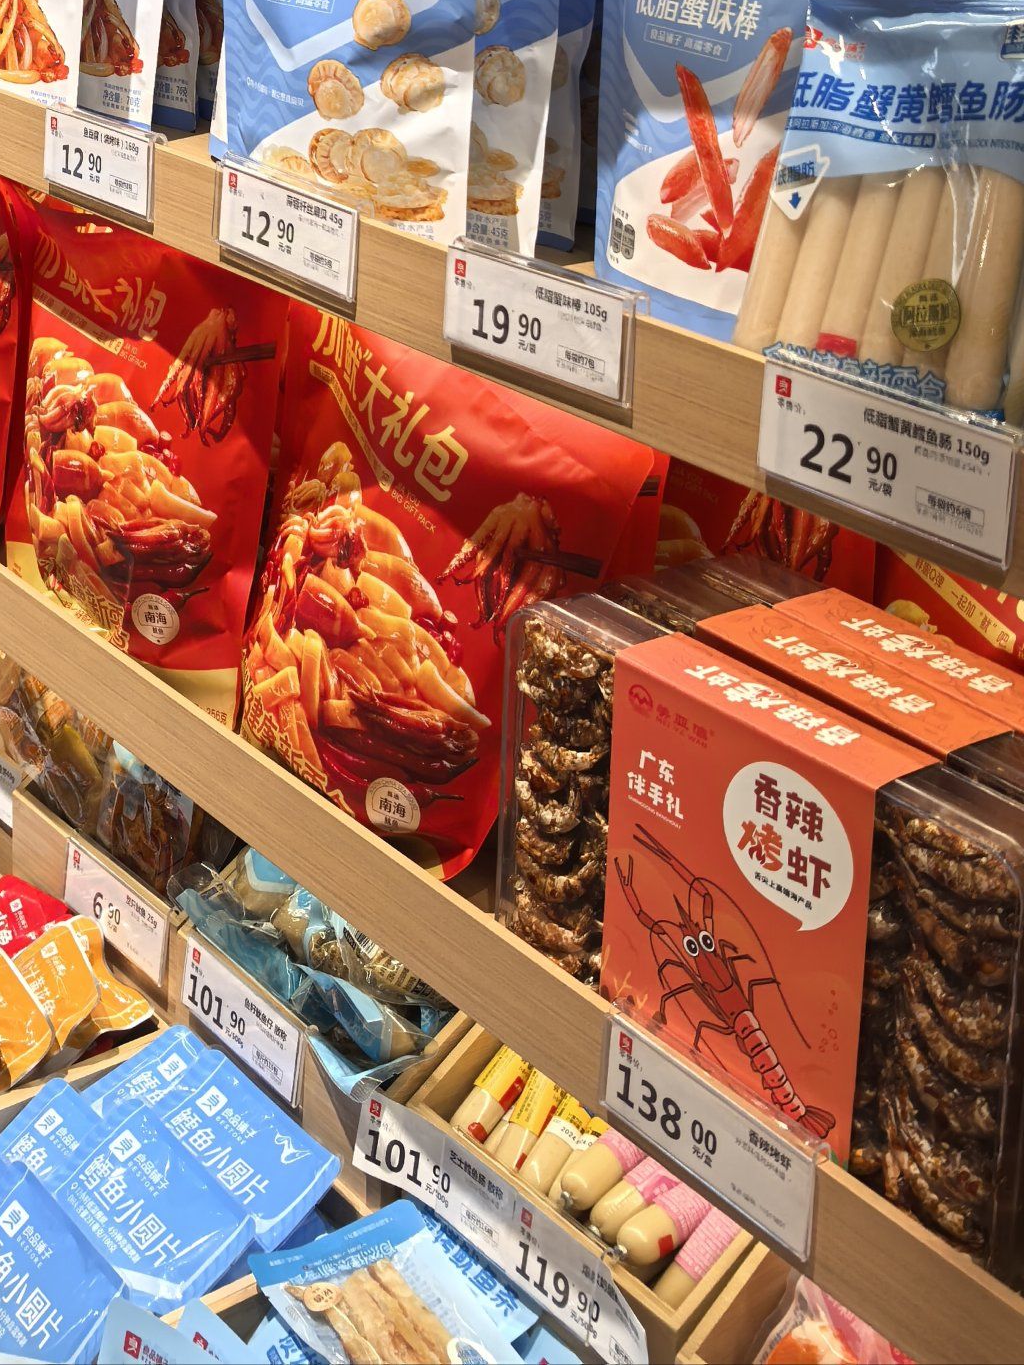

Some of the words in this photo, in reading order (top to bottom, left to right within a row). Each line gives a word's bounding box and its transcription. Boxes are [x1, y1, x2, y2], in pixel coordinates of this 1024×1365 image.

[62, 145, 84, 179] 12
[88, 153, 102, 174] 90
[241, 205, 271, 247] 12
[277, 219, 295, 243] 90
[329, 211, 343, 229] 45g
[472, 299, 510, 345] 19
[518, 313, 542, 341] 90
[584, 301, 608, 322] 105g
[799, 423, 855, 484] 22
[866, 446, 898, 481] 90
[956, 437, 990, 466] 150g
[403, 499, 420, 517] GIFT
[418, 512, 437, 534] PACK
[143, 610, 168, 626] 南海
[638, 749, 675, 786] 广东
[378, 796, 407, 819] 南海
[627, 771, 684, 820] 伴手礼
[754, 772, 824, 843] 香辣
[737, 820, 832, 899] 烤虾
[93, 891, 104, 920] 6
[108, 902, 121, 925] 90
[187, 974, 224, 1031] 101
[230, 1011, 246, 1036] 90
[221, 1106, 258, 1140] 良品铺子
[616, 1064, 682, 1141] 138
[691, 1119, 718, 1155] 00
[164, 1106, 271, 1206] 鳕鱼小圆片
[364, 1129, 422, 1187] 101
[431, 1165, 451, 1194] 90
[748, 1128, 792, 1172] 香辣烤虾
[133, 1152, 170, 1191] 良品铺子
[78, 1153, 182, 1268] 鳕鱼小圆片
[16, 1236, 43, 1269] BESTORE
[22, 1225, 53, 1260] 良品铺子
[515, 1241, 571, 1309] 119
[577, 1292, 601, 1324] 90
